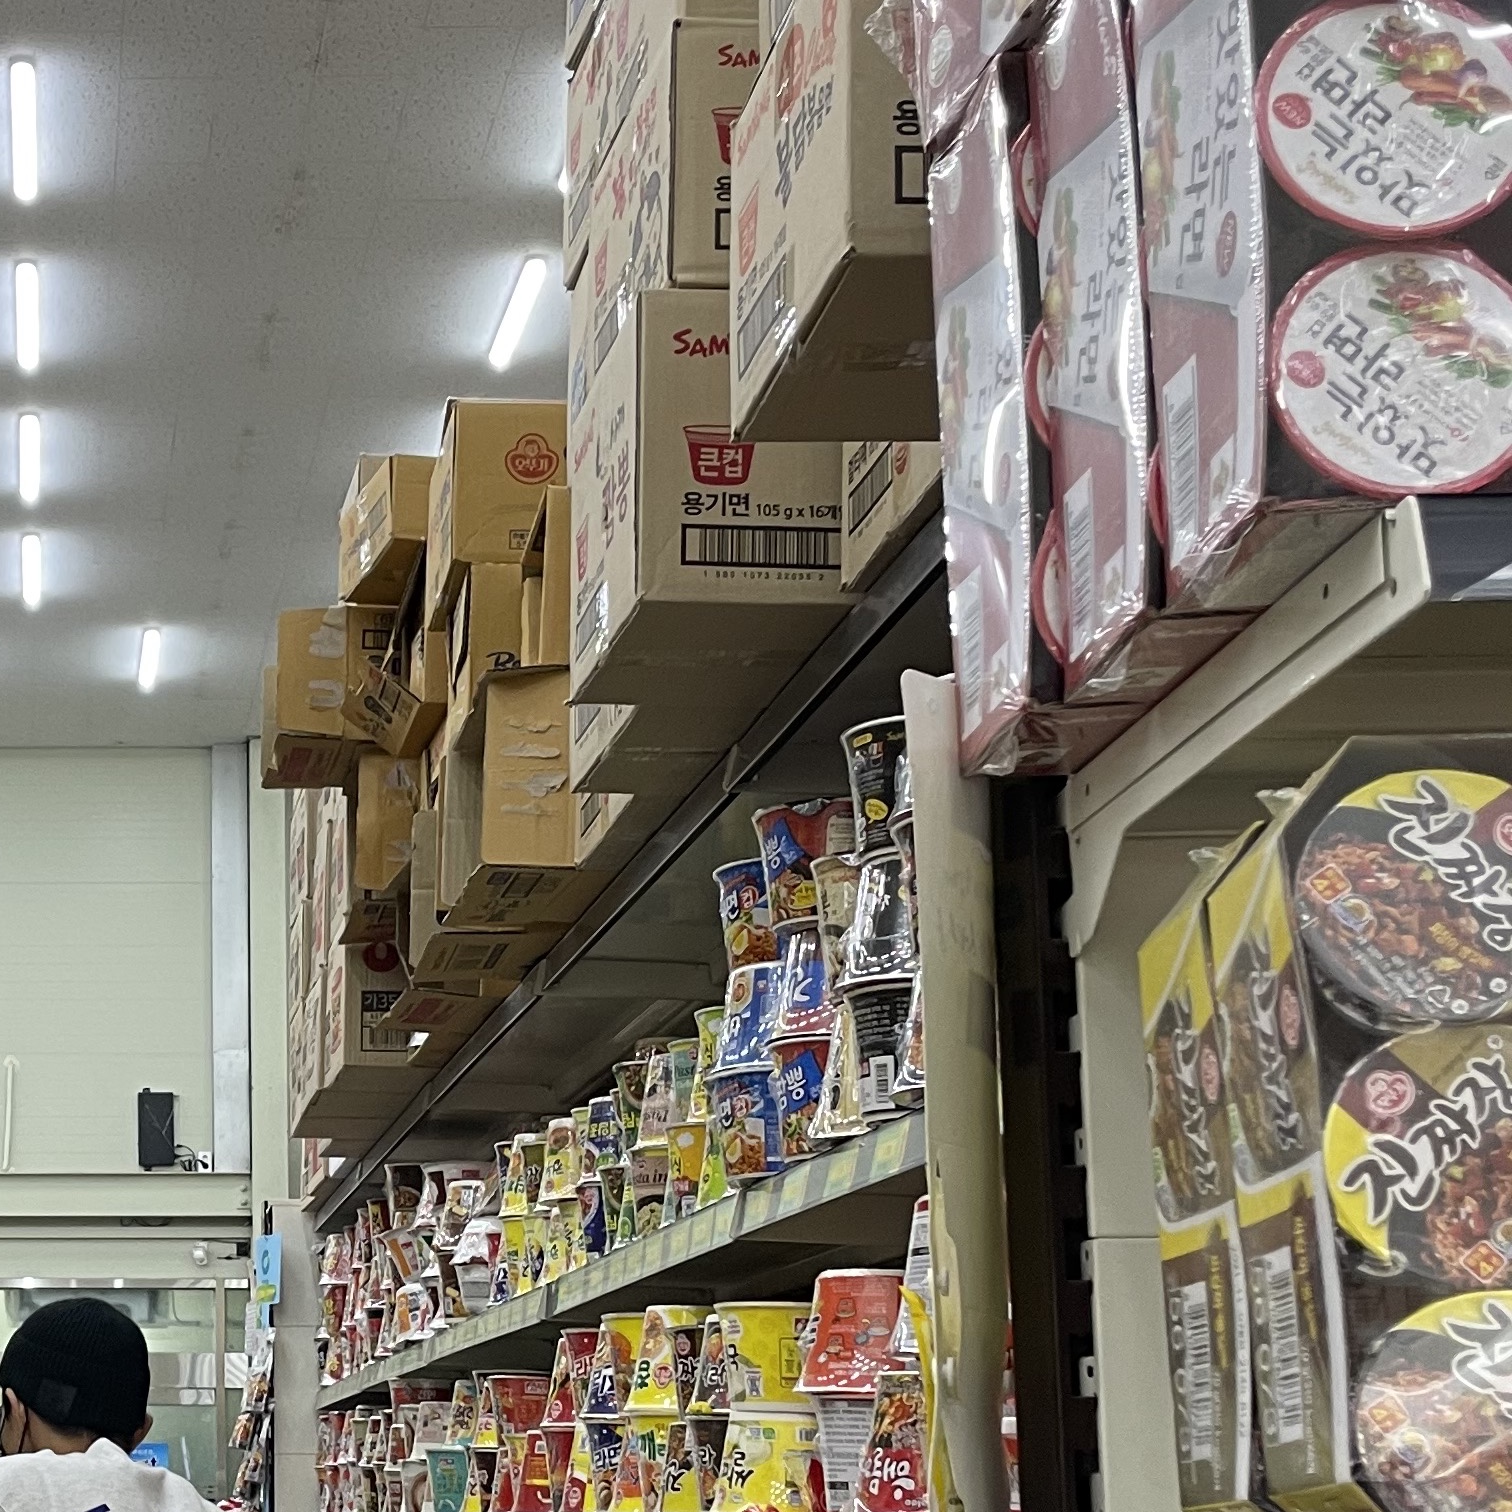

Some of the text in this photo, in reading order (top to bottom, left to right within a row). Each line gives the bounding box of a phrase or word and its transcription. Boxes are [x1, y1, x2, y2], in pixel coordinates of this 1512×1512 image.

[514, 455, 549, 472] 오뚜기
[697, 447, 743, 478] 큰컵
[680, 491, 750, 517] 용기면
[756, 504, 779, 517] 105
